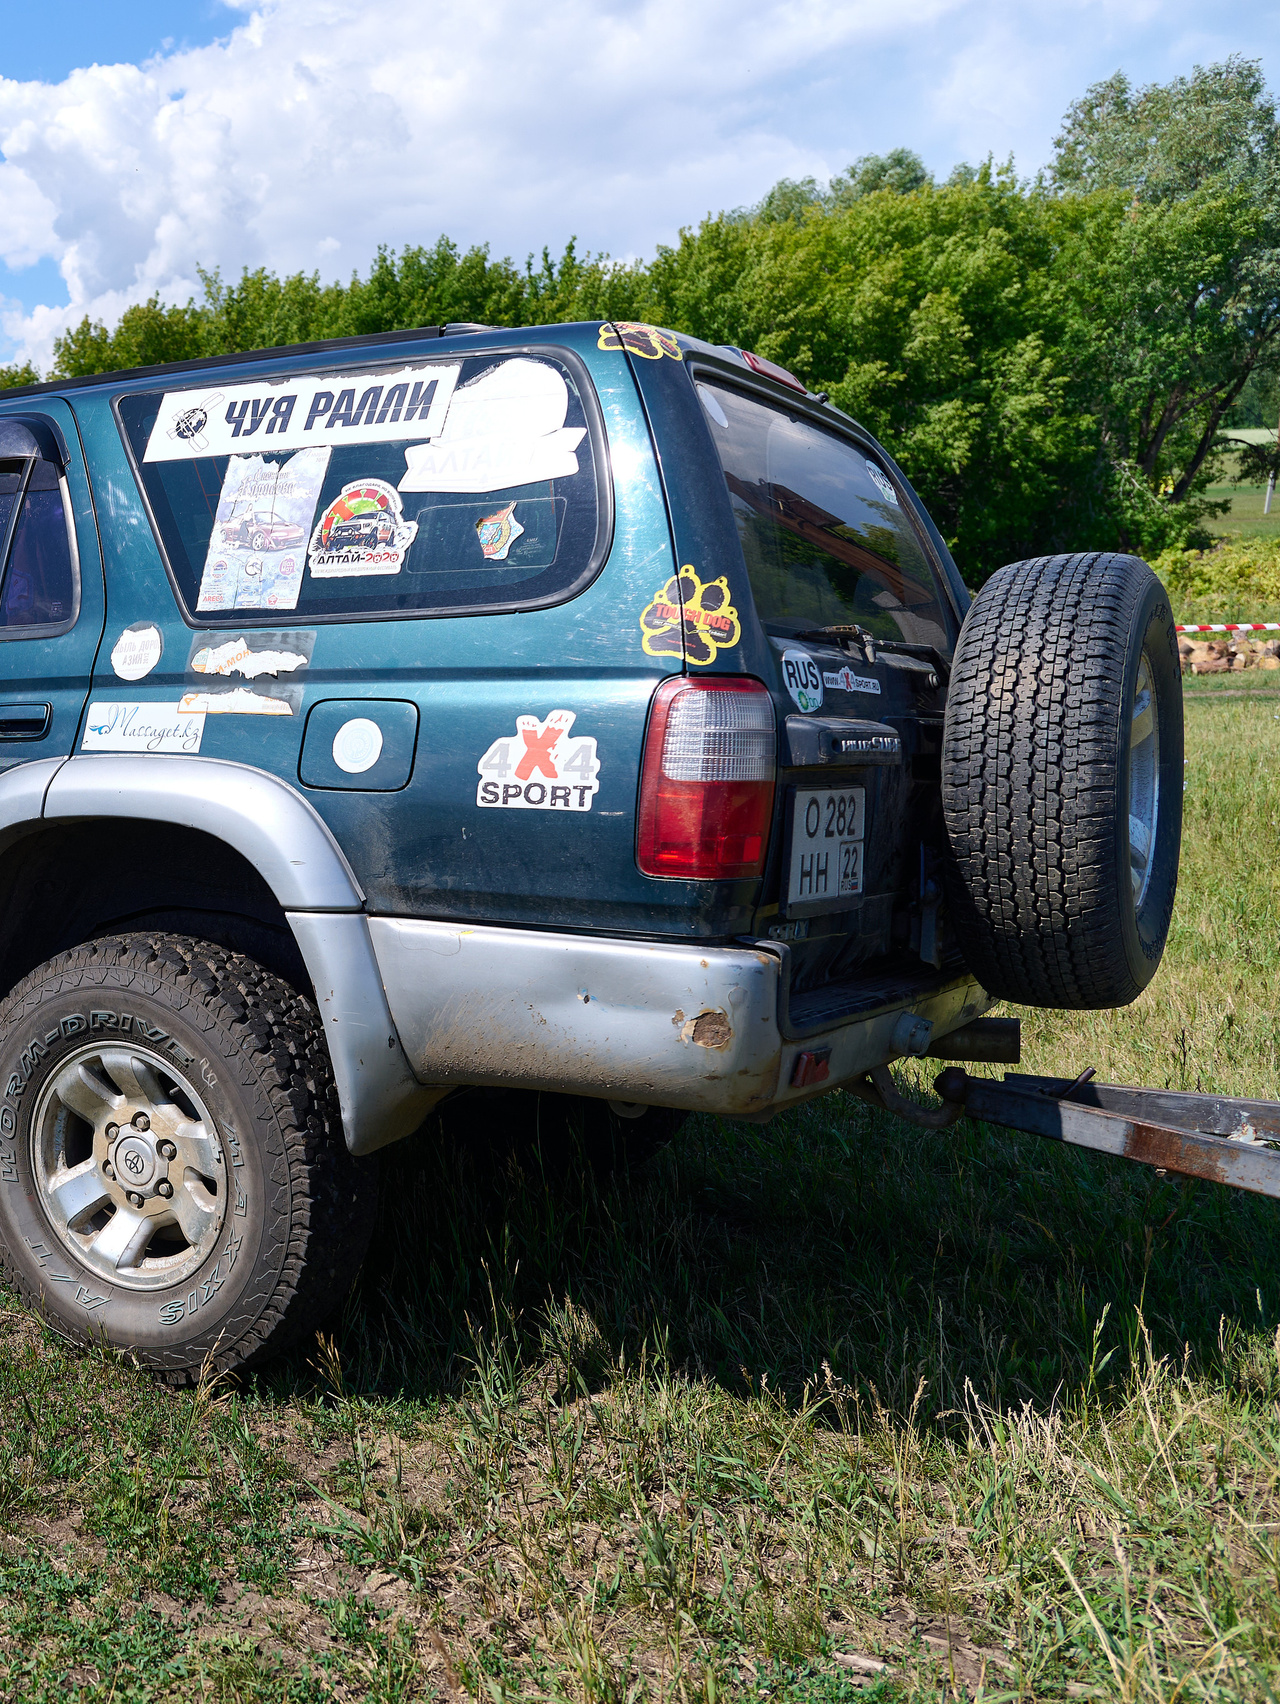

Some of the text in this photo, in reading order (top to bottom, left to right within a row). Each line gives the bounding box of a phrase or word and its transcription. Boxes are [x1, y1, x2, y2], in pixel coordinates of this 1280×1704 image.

[225, 379, 439, 438] ЧУЯ РАЛЛИ
[317, 551, 399, 565] АЛТАЙ-2020
[656, 604, 701, 623] TOUGH
[702, 611, 731, 631] DOG
[784, 660, 819, 690] RUS
[480, 781, 592, 809] SPORT
[825, 795, 856, 838] 282
[843, 847, 858, 879] 22
[841, 880, 852, 891] RUS
[0, 1009, 195, 1183] WORM-DRIVE
